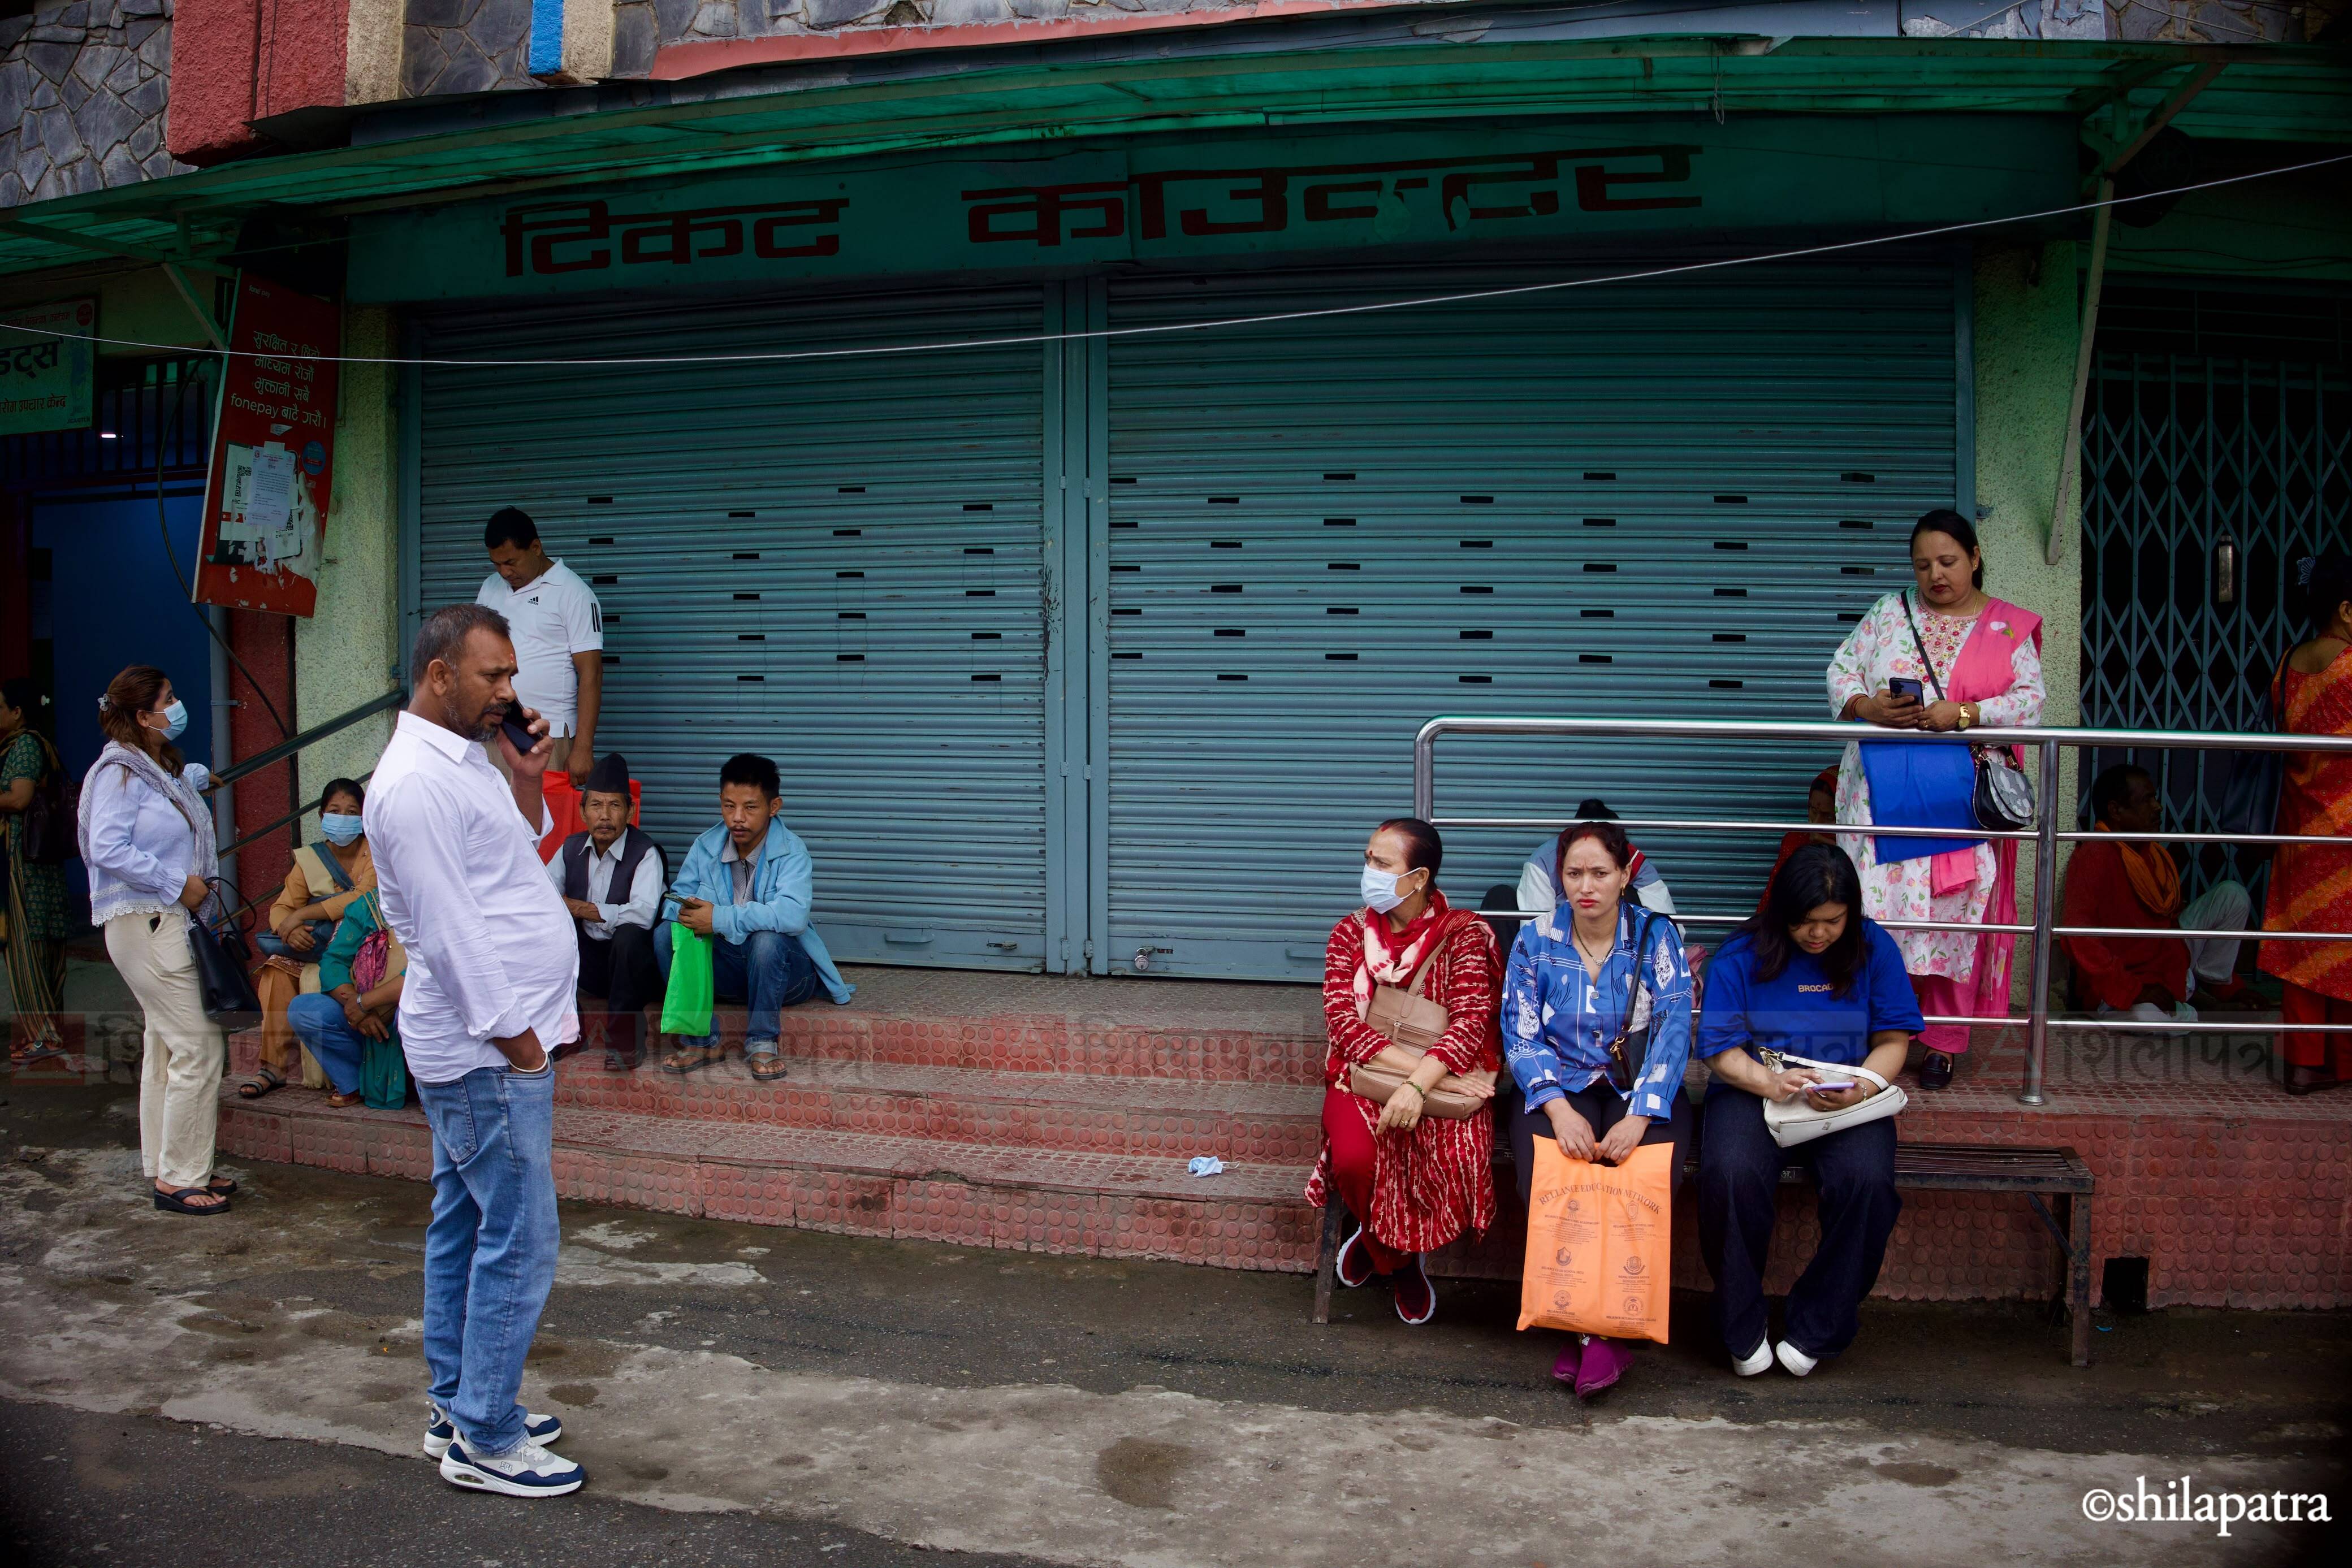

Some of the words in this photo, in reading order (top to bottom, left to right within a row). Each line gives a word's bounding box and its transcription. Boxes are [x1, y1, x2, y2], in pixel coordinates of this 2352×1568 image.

[500, 196, 849, 278] टिकट
[253, 330, 288, 354] सुरक्षित
[291, 343, 299, 356] र
[254, 376, 291, 399] भुक्तानी
[294, 384, 310, 404] सबै
[231, 393, 279, 419] fonepay
[1581, 1182, 1623, 1197] EDUCATION
[1625, 1189, 1663, 1215] NETWORK
